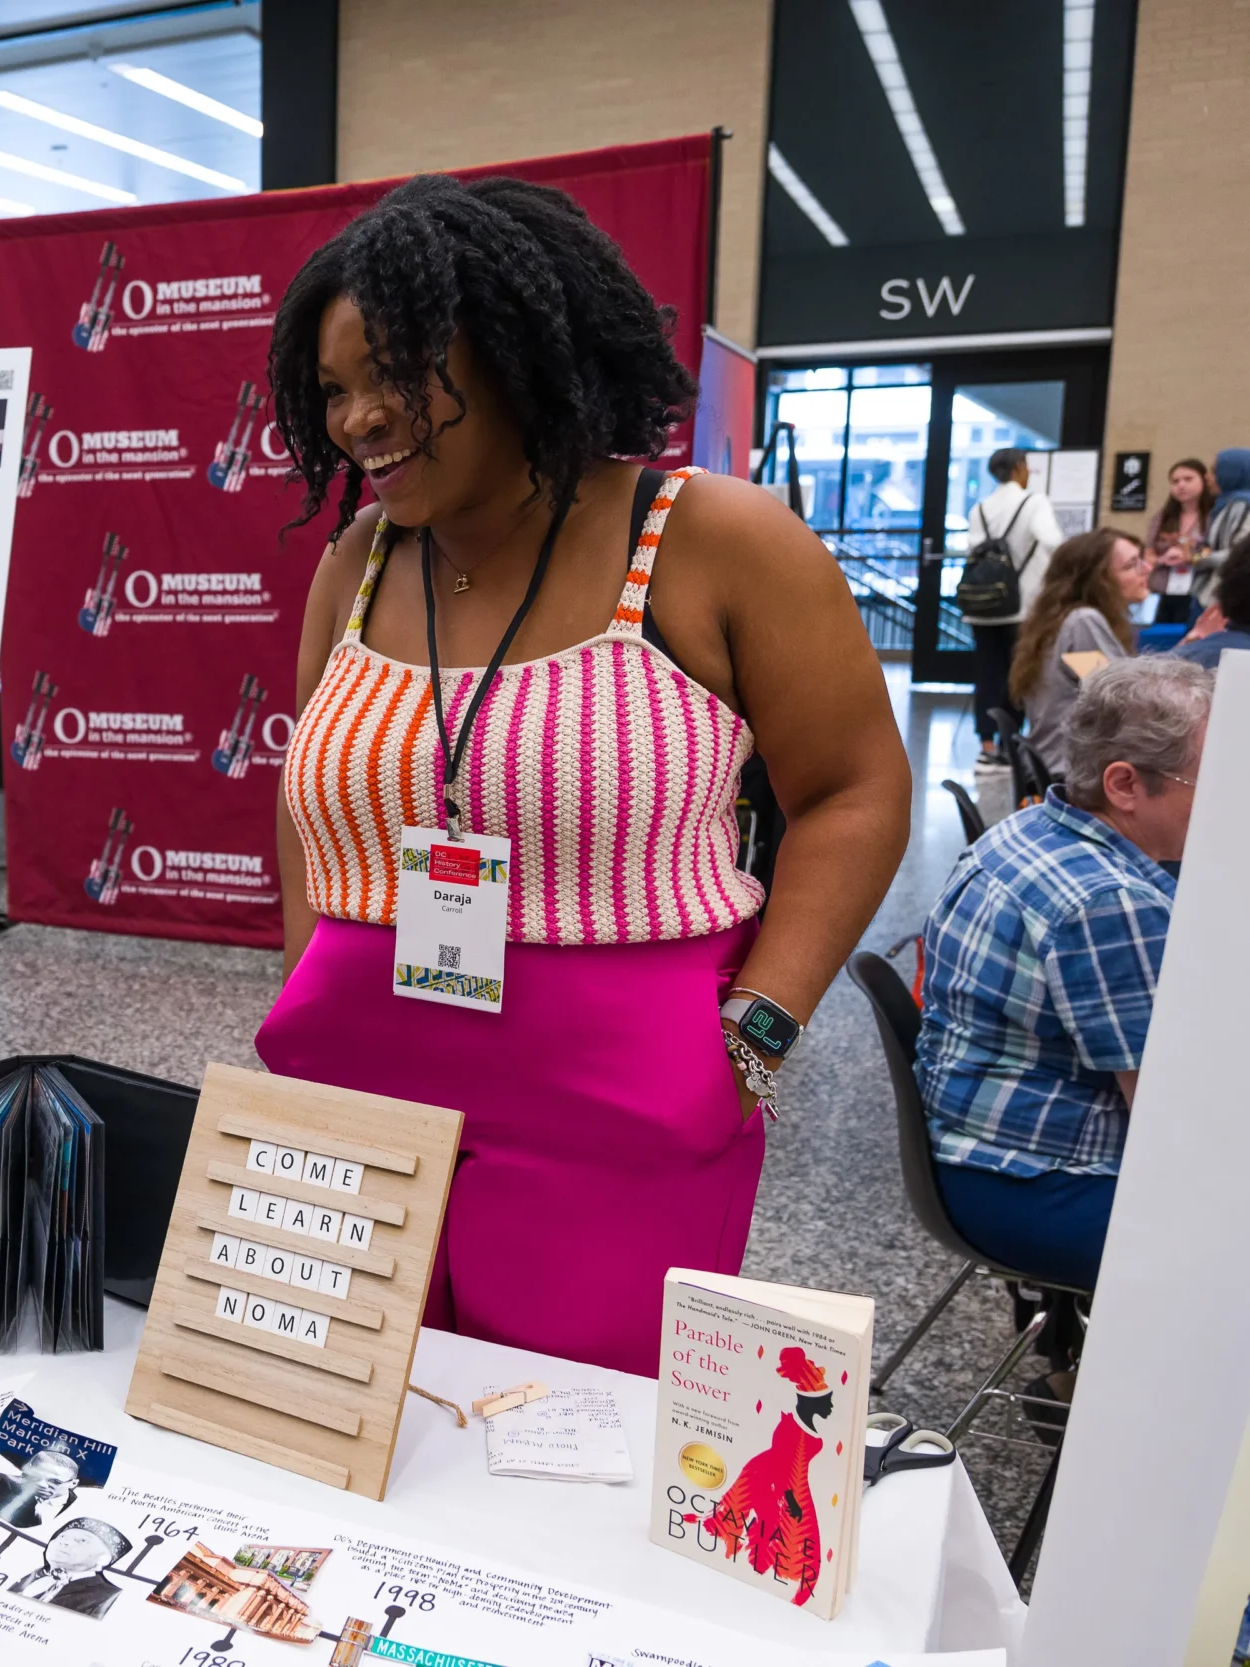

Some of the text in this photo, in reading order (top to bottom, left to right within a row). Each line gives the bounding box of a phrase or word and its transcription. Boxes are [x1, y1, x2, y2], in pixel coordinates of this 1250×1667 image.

[122, 274, 261, 320] O MUSEUM
[156, 303, 170, 315] in
[174, 300, 198, 314] the
[880, 274, 975, 320] SW
[48, 429, 180, 468] O MUSEUM
[82, 451, 94, 464] in
[96, 450, 118, 463] the
[124, 570, 262, 608] O MUSEUM
[161, 592, 175, 605] in
[178, 593, 199, 605] the
[54, 708, 184, 744] O MUSEUM
[88, 731, 100, 742] in
[102, 732, 124, 744] the
[131, 846, 262, 881] O MUSEUM
[166, 869, 178, 880] in
[182, 870, 201, 882] the
[434, 860, 460, 869] History
[434, 868, 476, 878] Conference
[434, 890, 472, 906] Daraja
[442, 906, 462, 914] Carroll
[256, 1150, 354, 1186] COME
[239, 1194, 364, 1242] LEARN
[218, 1244, 342, 1288] ABOUT
[224, 1296, 316, 1339] NOMA
[688, 1306, 720, 1318] Handmaid's
[750, 1323, 771, 1334] JOHN
[772, 1328, 797, 1342] GREEN,
[798, 1338, 812, 1346] New
[814, 1341, 827, 1350] York
[829, 1346, 846, 1356] Times
[716, 1306, 742, 1317] endlessly
[744, 1311, 755, 1320] rich
[767, 1320, 782, 1328] pairs
[783, 1324, 795, 1332] well
[797, 1327, 810, 1336] with
[812, 1332, 827, 1342] 1984
[675, 1319, 744, 1354] Parable
[672, 1347, 730, 1376] of the
[670, 1370, 731, 1402] Sower
[8, 1410, 112, 1455] Meridian Hill
[672, 1416, 733, 1444] N. K. JEMISIN
[703, 1410, 726, 1422] foreword
[2, 1420, 88, 1460] Malcolm X
[682, 1454, 694, 1462] NEW
[696, 1460, 708, 1468] YORK
[688, 1464, 716, 1477] BESTSELLER
[108, 1493, 127, 1502] first
[131, 1499, 156, 1509] North
[160, 1504, 205, 1519] American
[207, 1516, 240, 1528] concert
[122, 1487, 250, 1521] The Beatles performed their
[138, 1514, 199, 1541] 1964
[241, 1531, 269, 1542] Arena
[667, 1486, 822, 1563] OCTAVIA E.
[668, 1508, 816, 1598] BUTLER
[348, 1546, 376, 1558] issued
[437, 1567, 458, 1579] Plan
[476, 1578, 520, 1596] Prosperity
[564, 1601, 598, 1618] century
[352, 1555, 386, 1570] coining
[391, 1564, 404, 1572] the
[410, 1568, 430, 1580] term
[471, 1586, 488, 1596] and
[493, 1592, 536, 1610] describing
[554, 1608, 574, 1618] area
[356, 1540, 412, 1558] Department
[426, 1556, 461, 1573] Housing
[464, 1568, 481, 1576] and
[486, 1572, 542, 1594] Community
[548, 1587, 613, 1610] Development
[374, 1582, 436, 1612] 1998
[384, 1570, 406, 1580] place
[505, 1604, 574, 1625] redevelopment
[459, 1600, 545, 1627] and reinvestment
[20, 1630, 49, 1645] Arena
[377, 1640, 493, 1667] MASSACHUS
